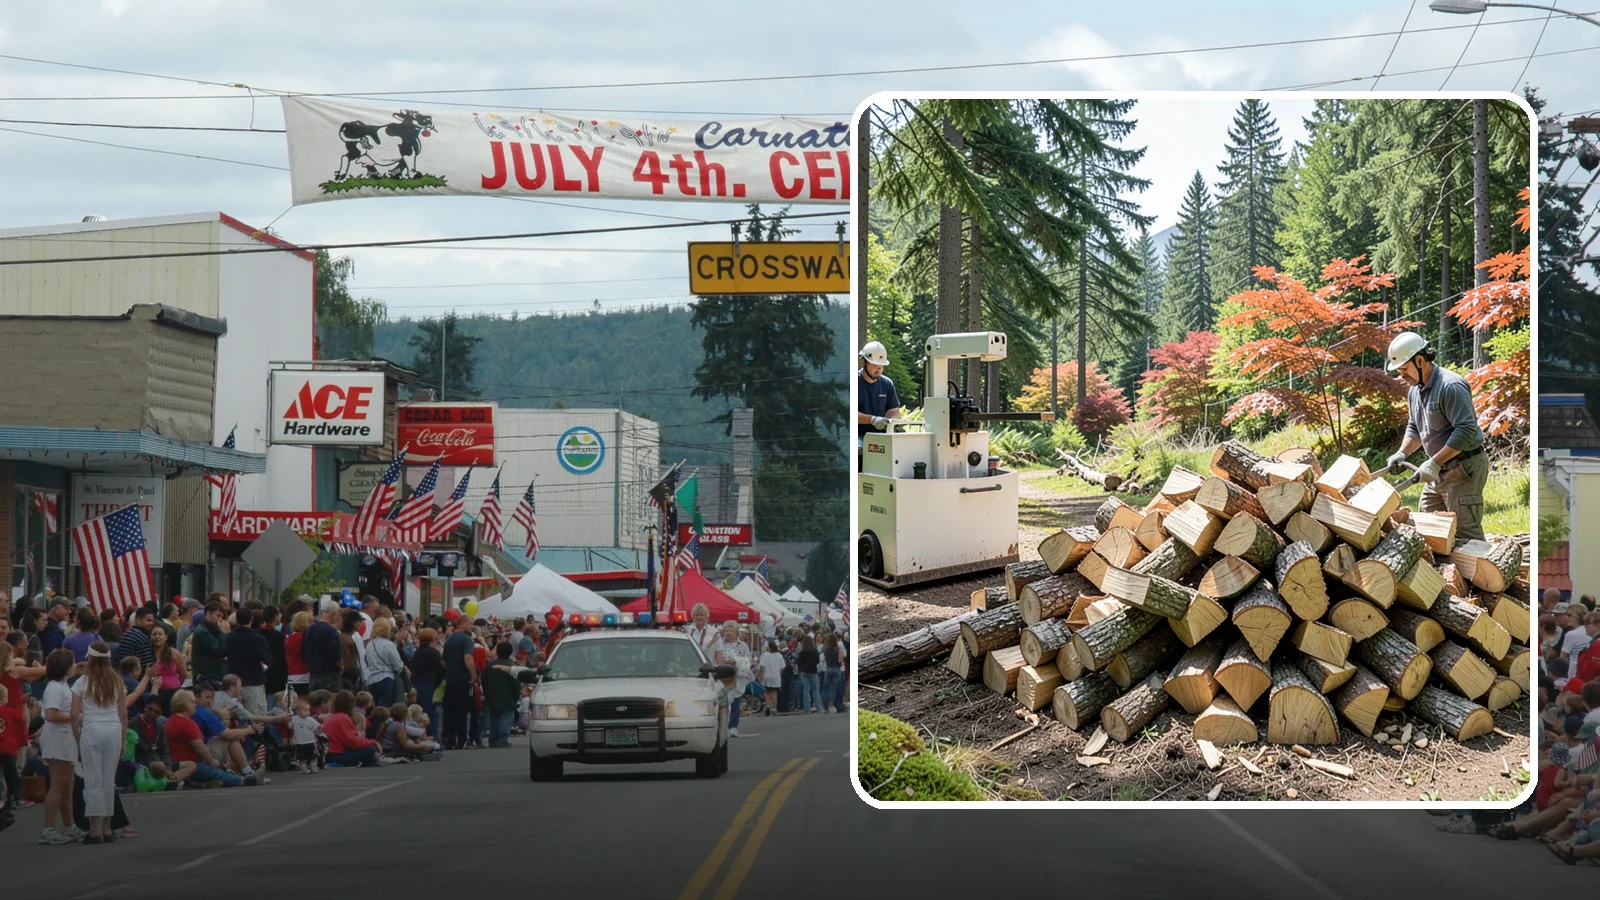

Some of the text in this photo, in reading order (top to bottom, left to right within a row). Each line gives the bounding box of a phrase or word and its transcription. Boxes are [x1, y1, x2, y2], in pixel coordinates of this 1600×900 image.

[481, 141, 605, 193] JULY
[632, 150, 747, 198] 4th.
[697, 253, 850, 281] CROSSWA
[282, 380, 374, 420] ACE
[405, 409, 453, 422] CEDAR
[283, 421, 371, 437] Hardware
[416, 427, 477, 447] Coca-Cola
[353, 467, 386, 480] Simpl
[95, 484, 124, 494] Vincent
[126, 485, 136, 495] de
[138, 486, 155, 495] Paul
[81, 503, 154, 522] THRT
[212, 516, 330, 536] HARDARE
[688, 526, 741, 535] CRNATION
[699, 535, 730, 543] GLASS
